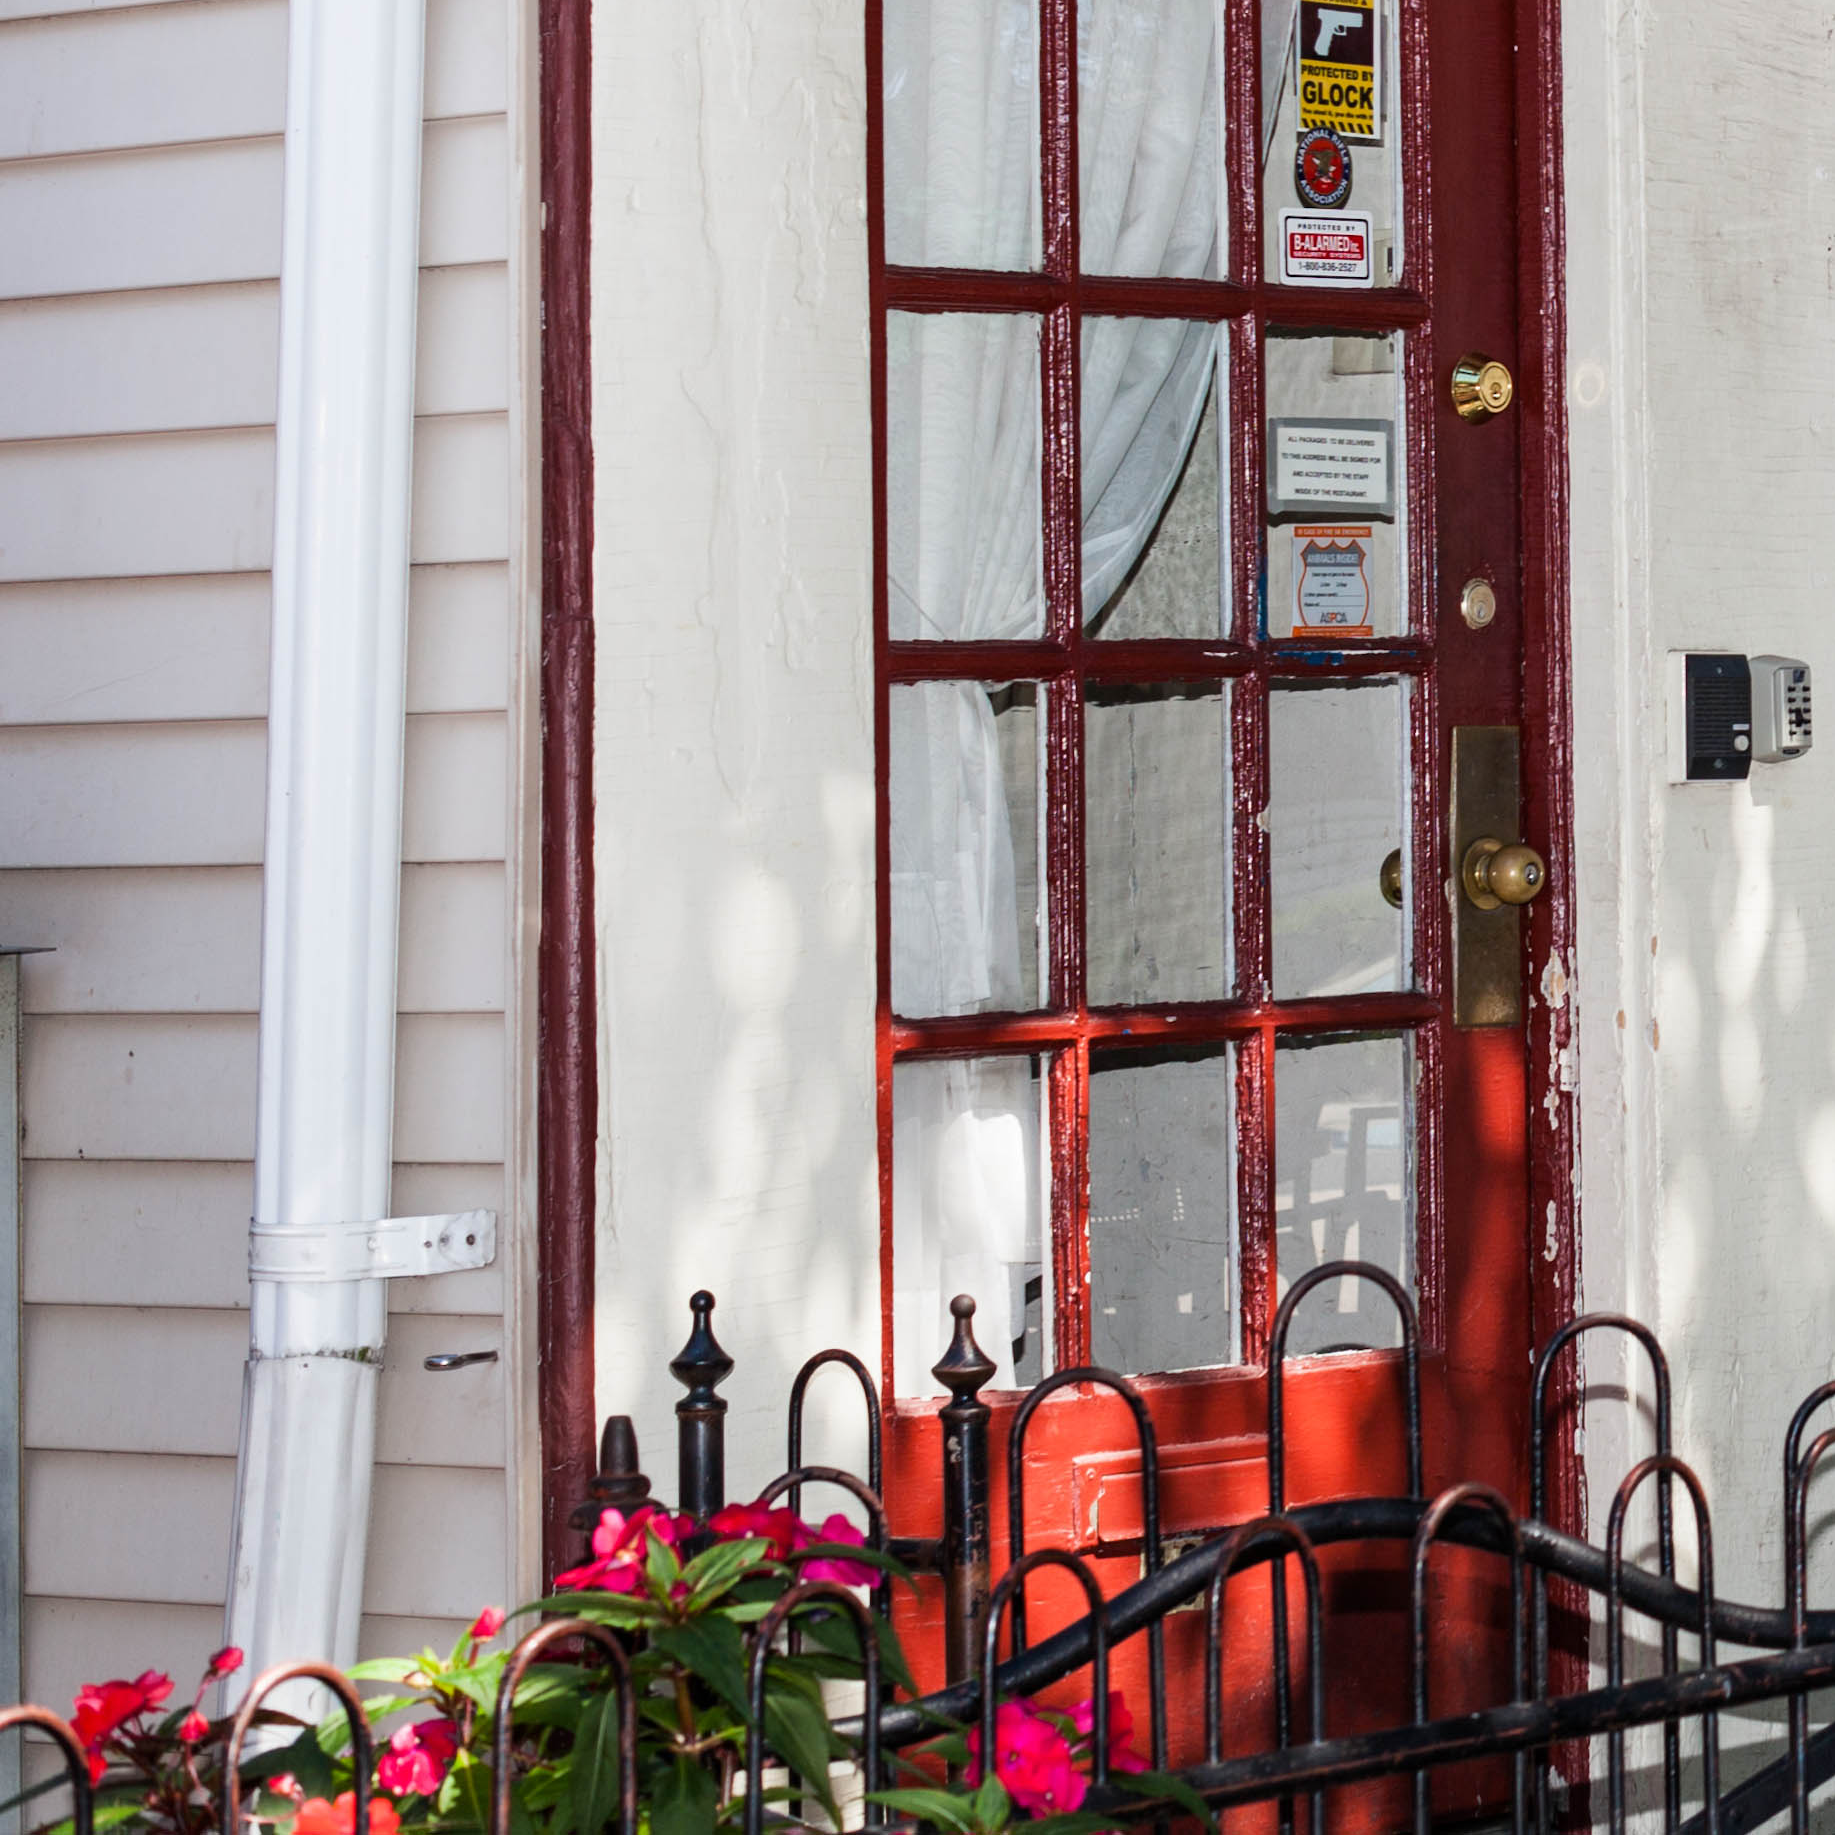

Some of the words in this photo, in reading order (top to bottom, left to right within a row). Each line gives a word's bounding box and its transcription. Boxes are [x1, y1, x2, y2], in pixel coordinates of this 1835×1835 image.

[1301, 63, 1359, 81] PROTECTED
[1302, 81, 1374, 110] GLOCK
[1297, 129, 1330, 164] NATIONAL
[1332, 133, 1350, 164] RIFLE
[1299, 178, 1349, 205] ASSOCIATION
[1297, 222, 1341, 232] PROTECTED
[1345, 224, 1356, 232] BY
[1293, 234, 1350, 252] B-ALARMED
[1320, 612, 1347, 624] ASPCA
